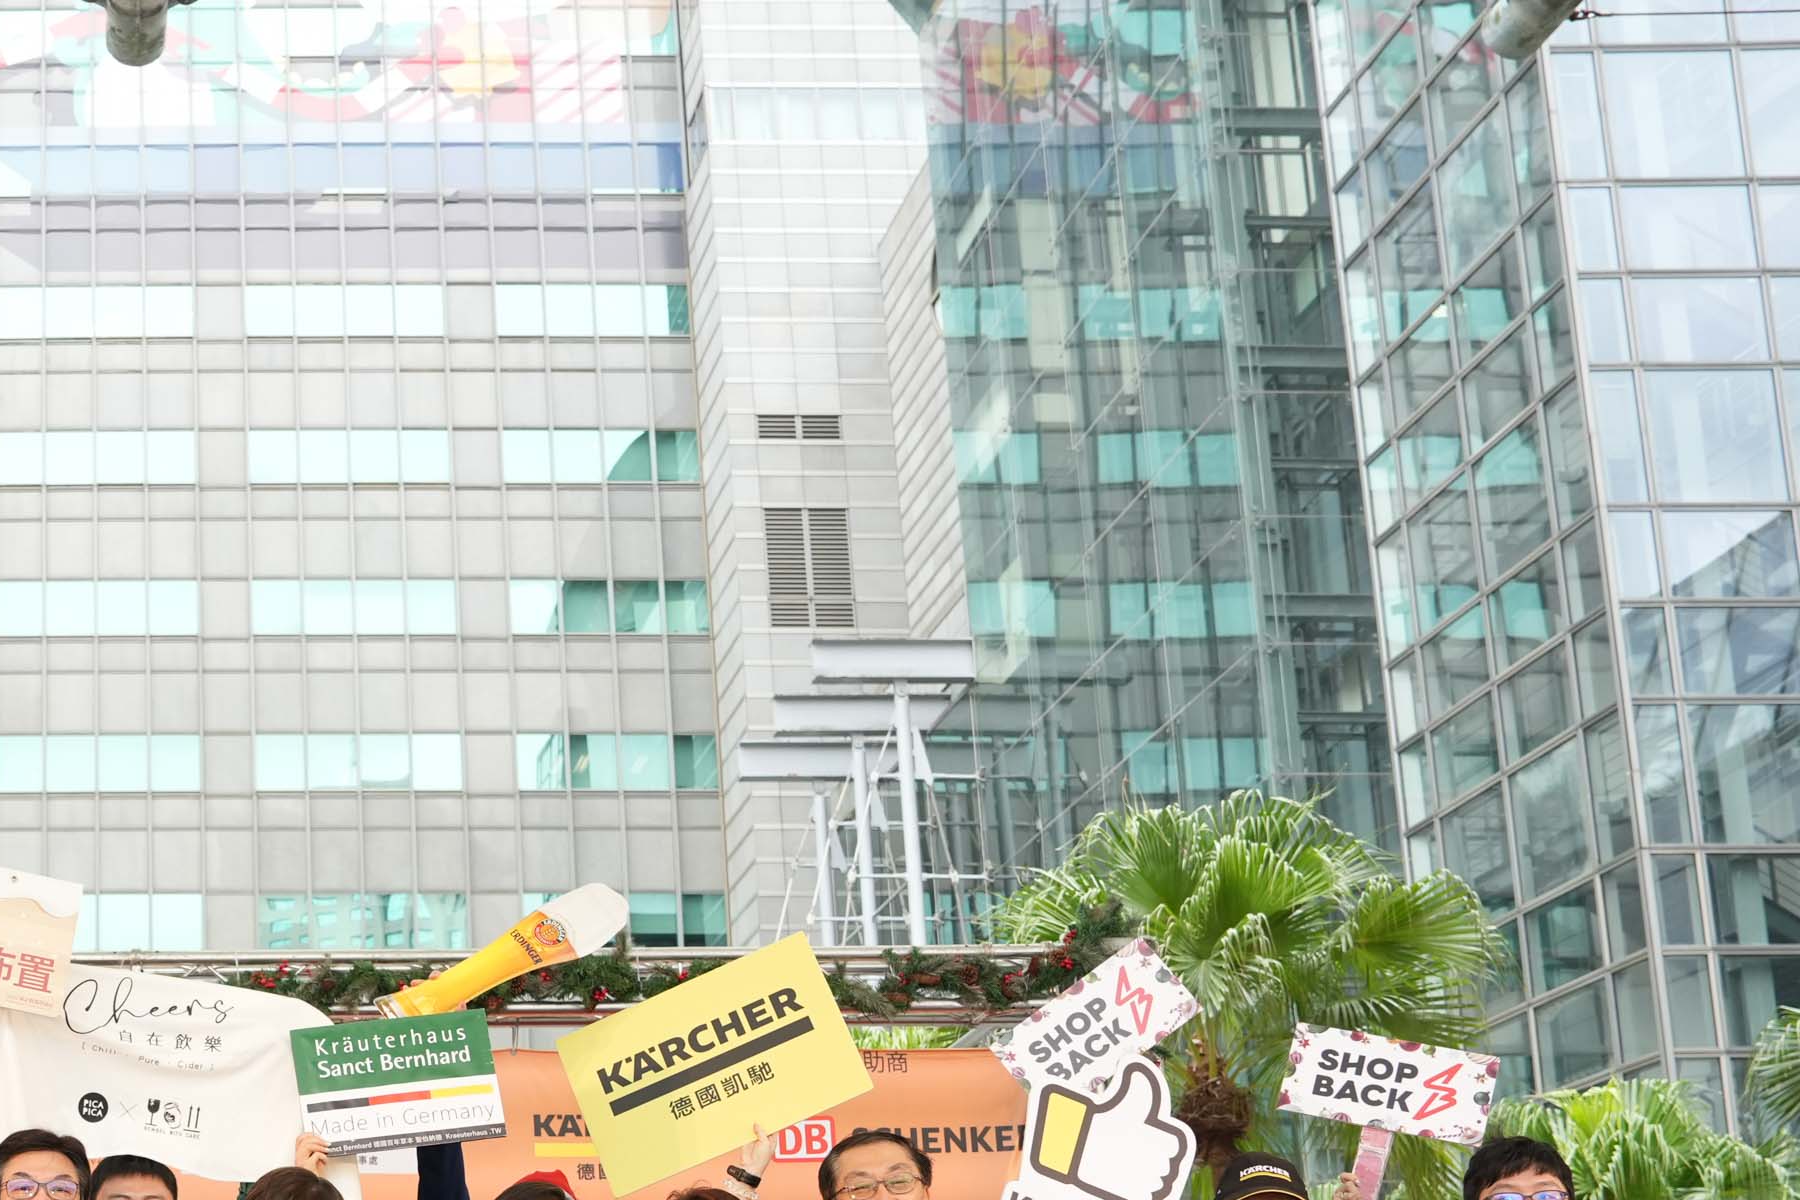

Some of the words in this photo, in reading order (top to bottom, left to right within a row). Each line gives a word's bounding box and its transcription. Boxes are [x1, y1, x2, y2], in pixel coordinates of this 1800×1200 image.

[510, 928, 543, 965] ERDINGER
[62, 976, 235, 1035] Cheers
[119, 1029, 223, 1053] 自在飲樂
[314, 1027, 467, 1056] Kräuterhaus
[596, 987, 805, 1094] KÄRCHER
[1028, 997, 1107, 1064] SHOP
[317, 1057, 375, 1079] Sanct
[380, 1045, 472, 1072] Bernhard
[1045, 1017, 1133, 1080] BACK
[1317, 1048, 1419, 1083] SHOP
[83, 1099, 104, 1110] PICA
[669, 1061, 775, 1120] 德國凱馳
[1312, 1074, 1414, 1112] BACK
[82, 1107, 103, 1117] PICA
[310, 1113, 368, 1136] Made
[376, 1111, 394, 1129] in
[403, 1103, 495, 1127] Germany
[778, 1123, 829, 1156] DB
